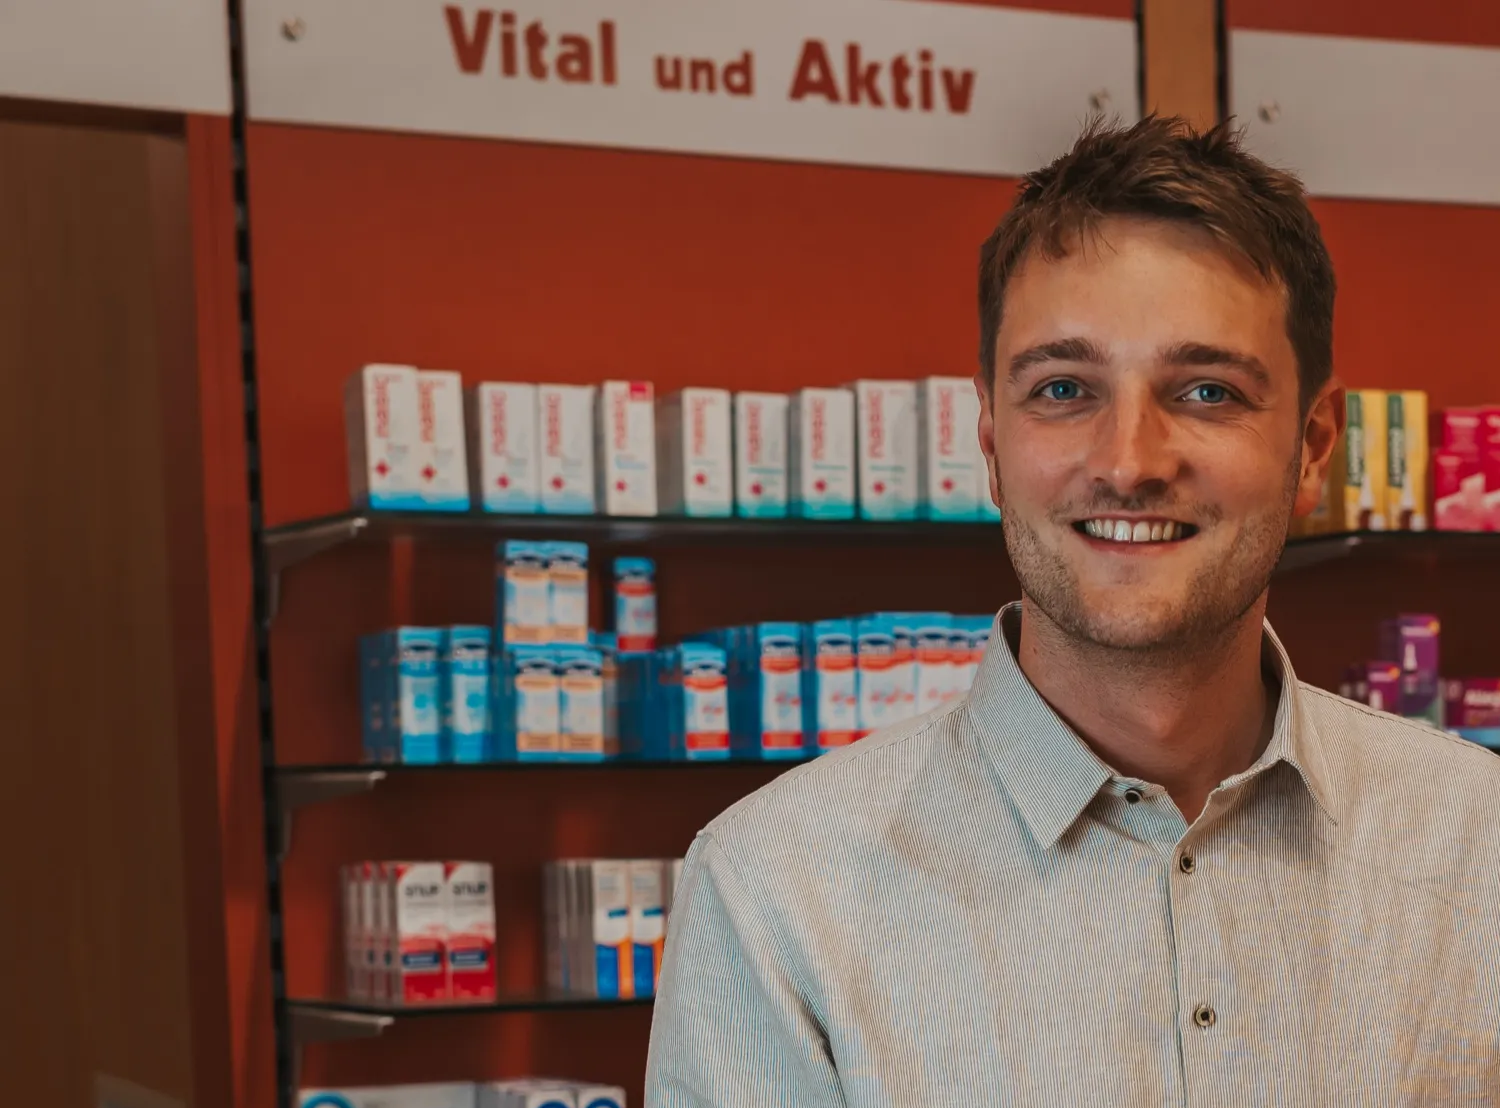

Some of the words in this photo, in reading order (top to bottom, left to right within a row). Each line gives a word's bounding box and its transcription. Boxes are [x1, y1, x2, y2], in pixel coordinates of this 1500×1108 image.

[445, 6, 617, 86] Vital
[655, 51, 753, 97] und
[789, 40, 975, 115] Aktiv
